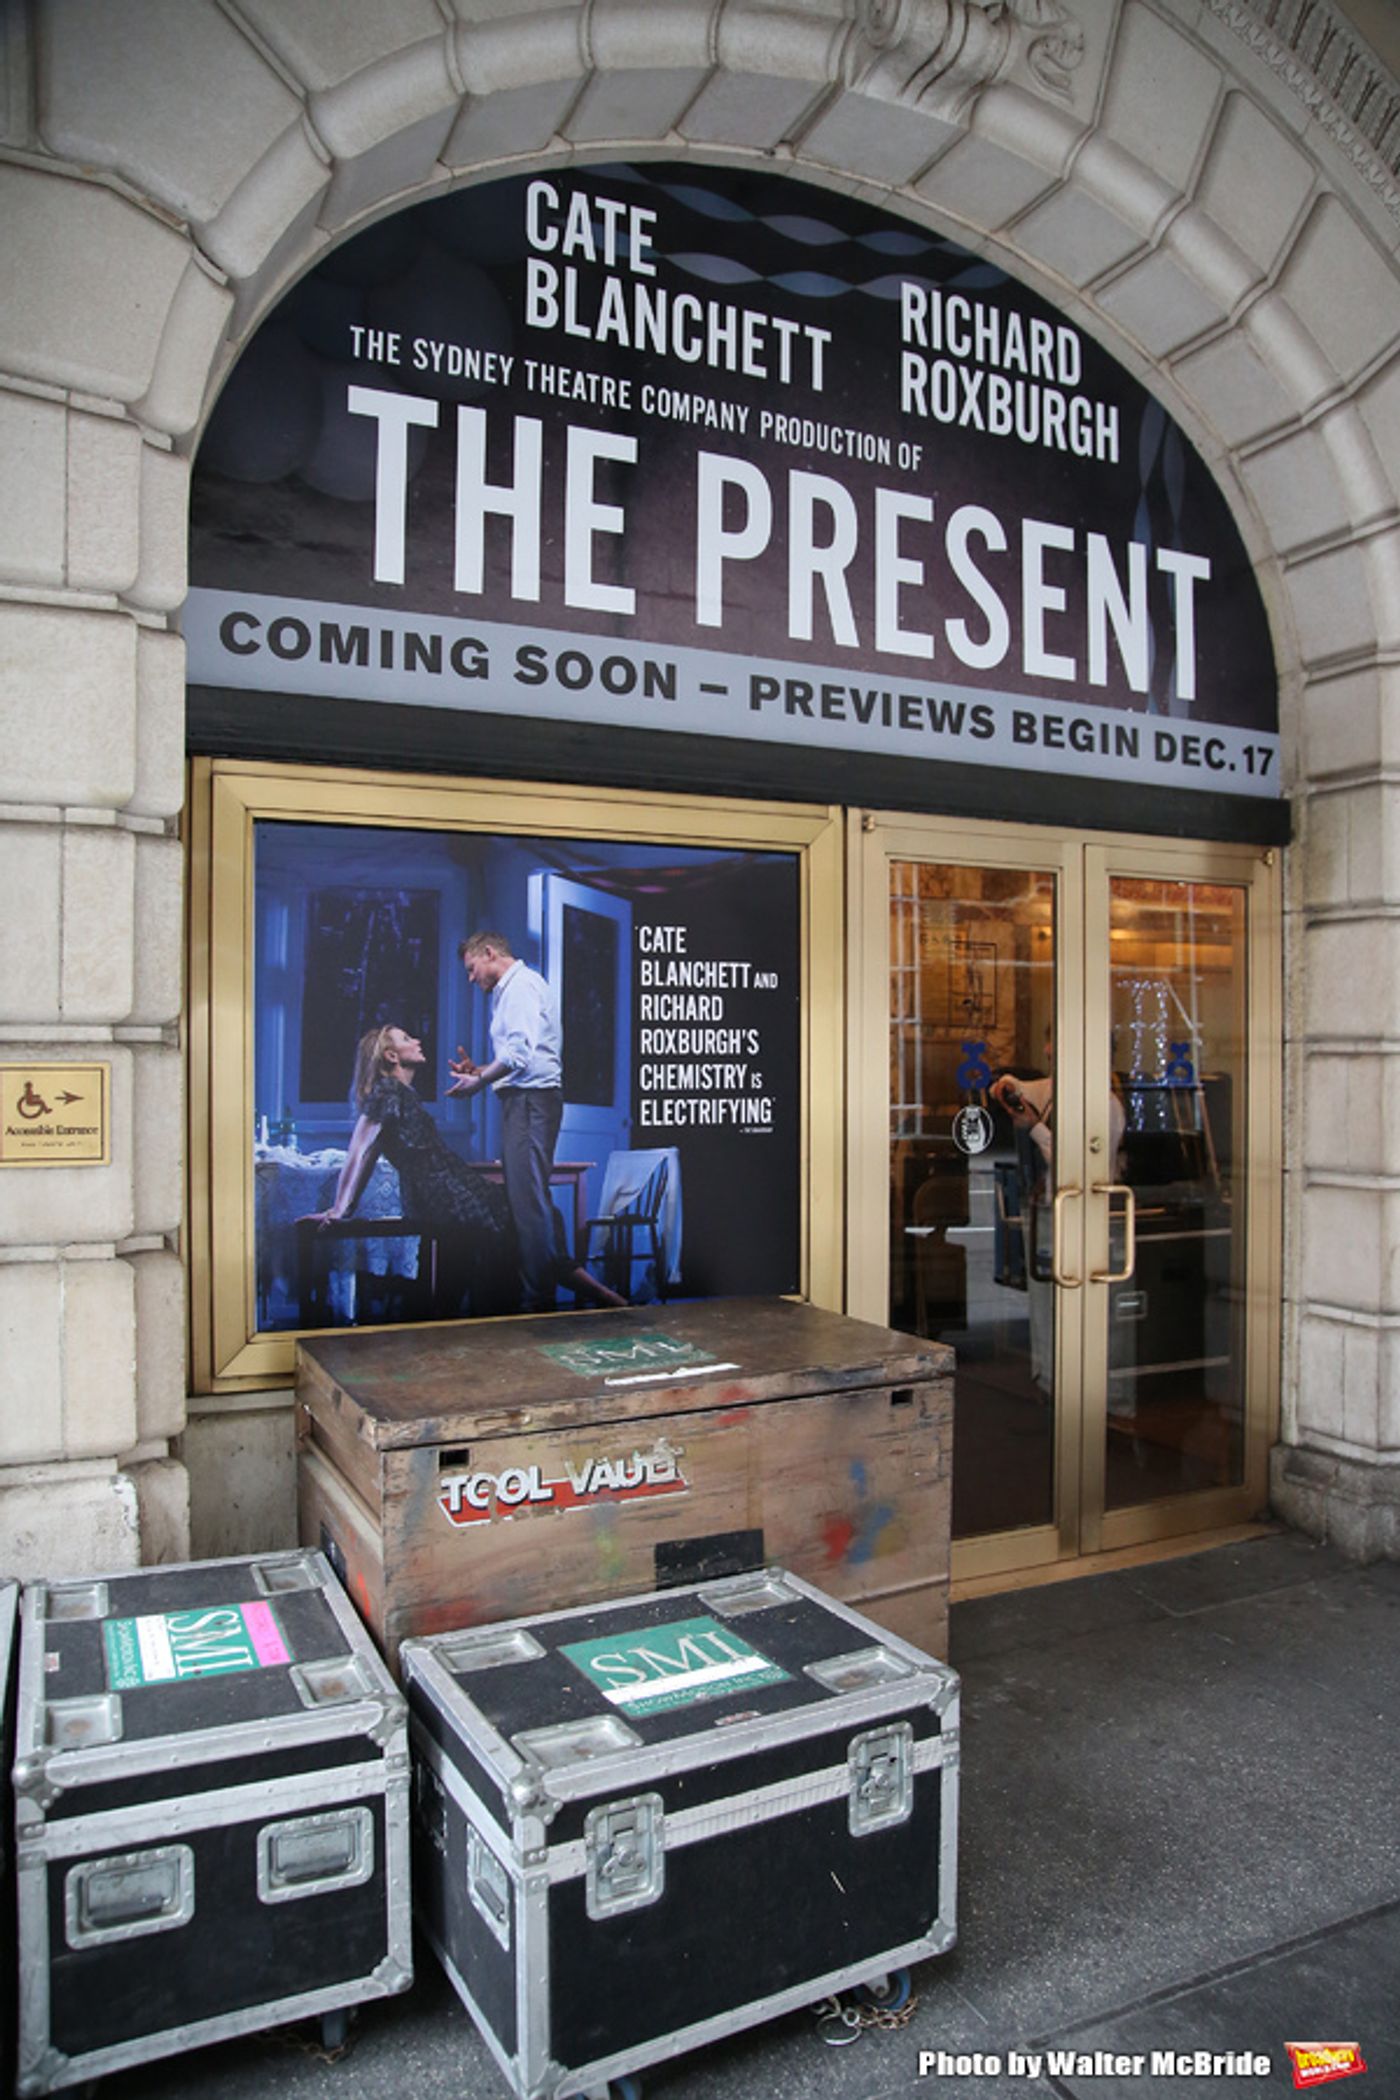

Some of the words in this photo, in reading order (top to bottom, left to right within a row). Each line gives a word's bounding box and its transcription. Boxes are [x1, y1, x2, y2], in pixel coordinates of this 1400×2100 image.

[526, 181, 657, 276] CATE
[526, 257, 832, 392] BLANCHETT
[900, 281, 1082, 387] RICHARD
[349, 325, 401, 365] THE
[412, 337, 514, 386] SYDNEY
[524, 360, 631, 410] THEATRE
[641, 384, 750, 434] COMPANY
[760, 411, 892, 468] PRODUCTION
[898, 441, 923, 471] OF
[901, 350, 1120, 464] ROXBURGH
[347, 385, 638, 616] THE
[696, 450, 1211, 701] PRESENT
[218, 611, 490, 680] COMING
[513, 644, 677, 701] SOON
[749, 673, 996, 740] PREVIEWS
[1011, 709, 1140, 758] BEGIN
[1154, 730, 1237, 772] DEC.
[1242, 743, 1275, 776] 17
[641, 960, 751, 989] BLANCHETT
[753, 972, 779, 989] AND
[641, 994, 723, 1021] RICHARD
[640, 1063, 747, 1091] CHEMISTRY
[751, 1072, 763, 1089] IS
[641, 1029, 760, 1055] ROXBURGH'S
[441, 1465, 554, 1513] TOOL
[167, 1610, 253, 1676] SMI
[590, 1631, 756, 1689] SMI
